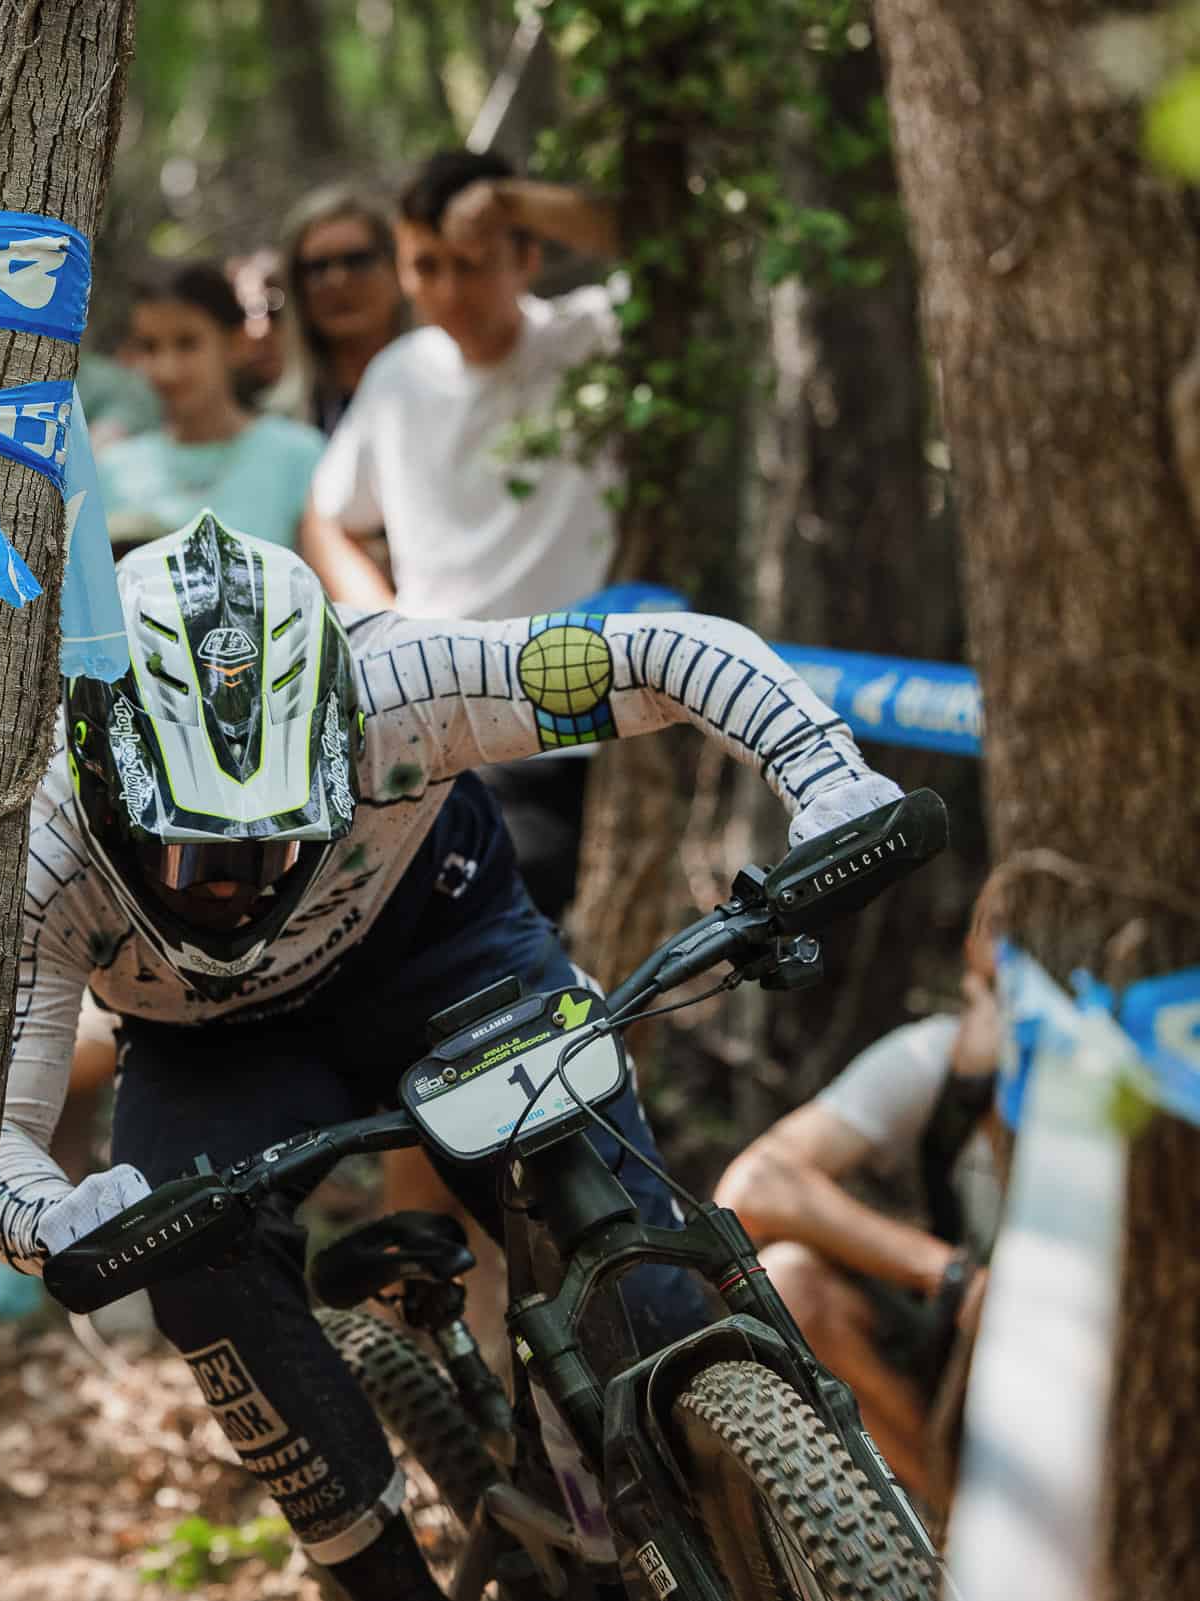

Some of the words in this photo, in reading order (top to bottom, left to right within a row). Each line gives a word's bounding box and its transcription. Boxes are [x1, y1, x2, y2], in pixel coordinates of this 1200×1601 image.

[471, 1014, 513, 1040] MELAMED
[460, 1049, 512, 1080] OUTDOOR
[511, 1031, 552, 1054] REGION
[507, 1063, 538, 1101] 1
